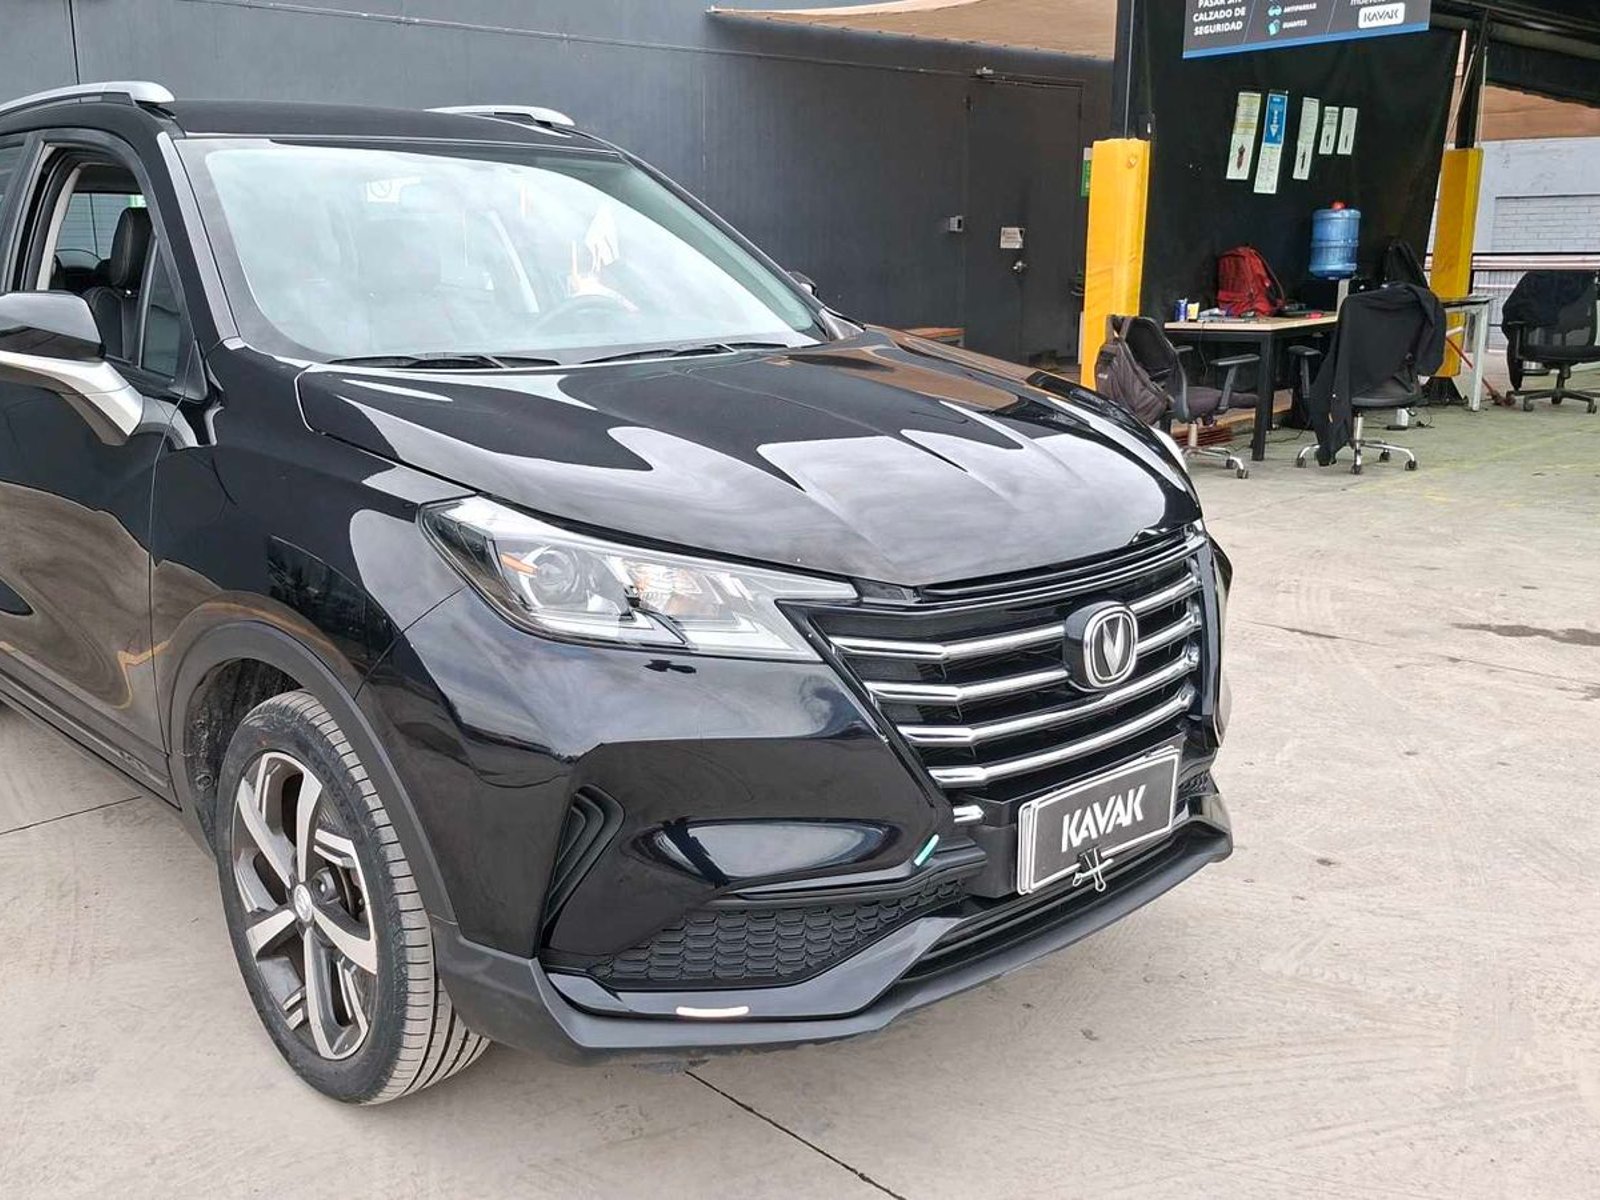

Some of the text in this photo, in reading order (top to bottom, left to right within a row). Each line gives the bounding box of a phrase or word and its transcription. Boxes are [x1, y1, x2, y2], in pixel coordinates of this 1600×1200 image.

[1193, 6, 1246, 23] CALZADO DE
[1363, 8, 1399, 23] KAVAK
[1194, 20, 1243, 36] SEGURIDAD
[1062, 784, 1147, 853] KAVAK
